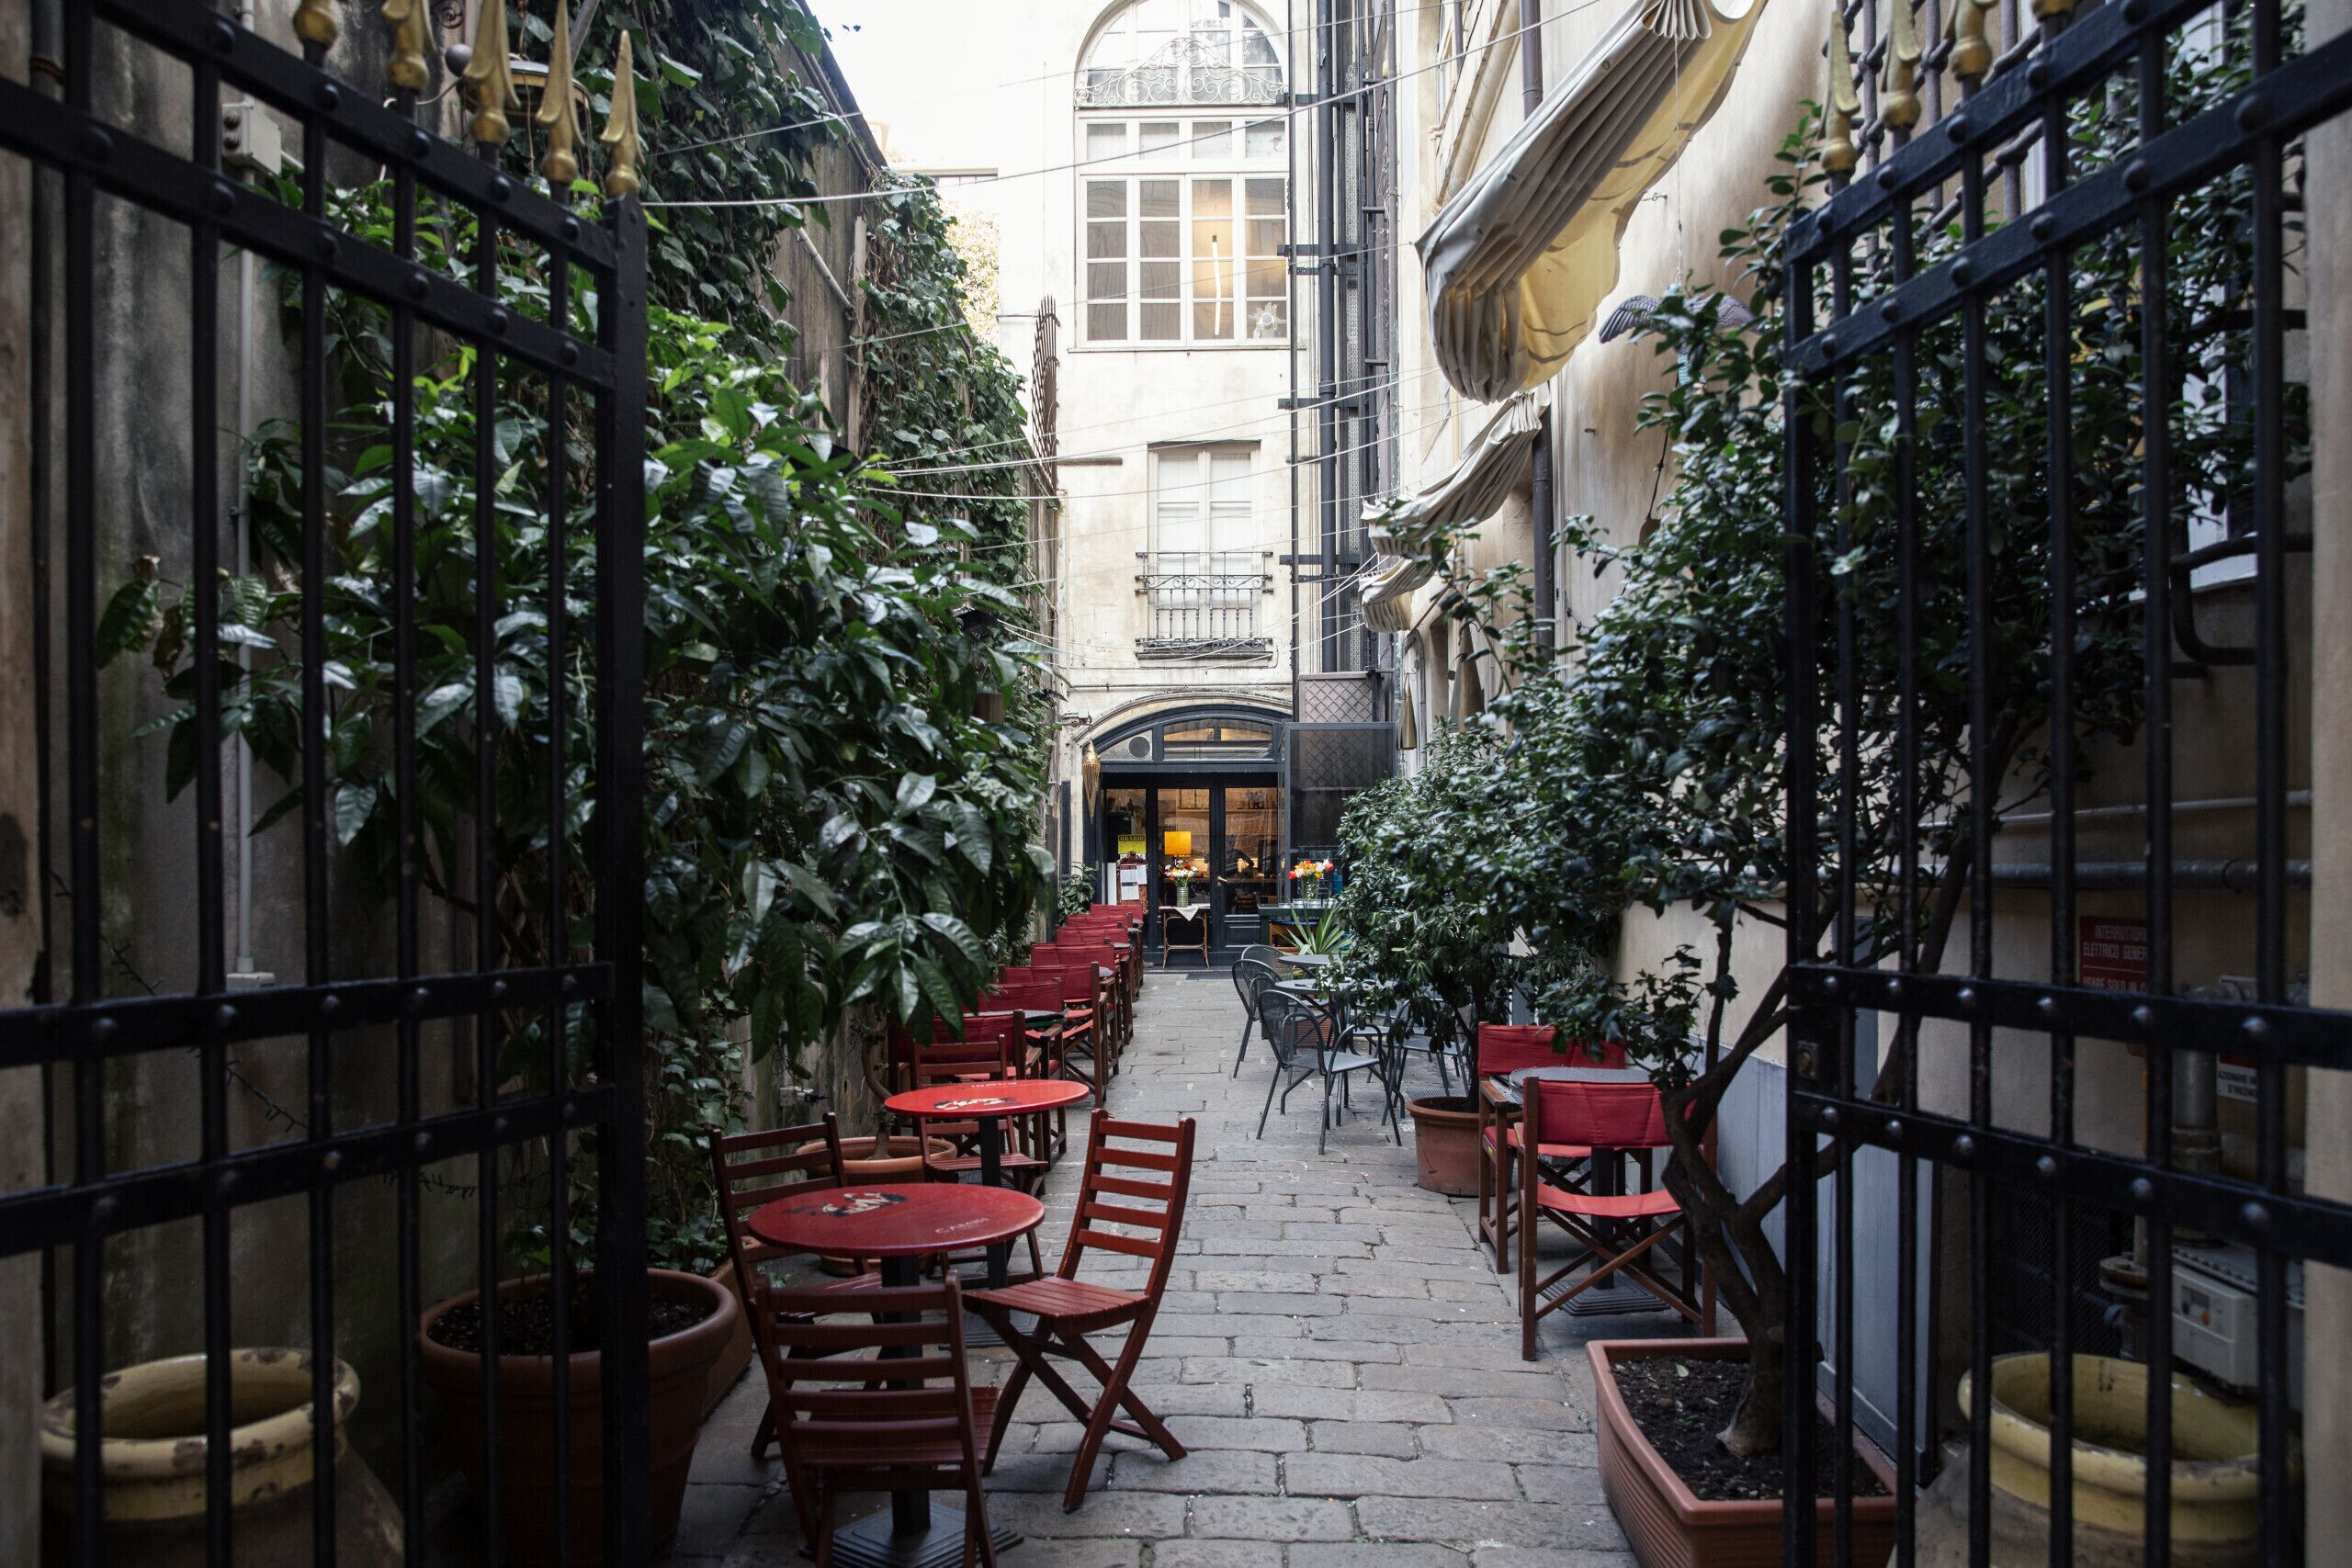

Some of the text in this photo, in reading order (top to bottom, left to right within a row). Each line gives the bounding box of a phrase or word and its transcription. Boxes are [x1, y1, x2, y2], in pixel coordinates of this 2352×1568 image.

[2083, 942, 2147, 961] ELETTRICO GENE
[2228, 1084, 2258, 1097] D'INCEN
